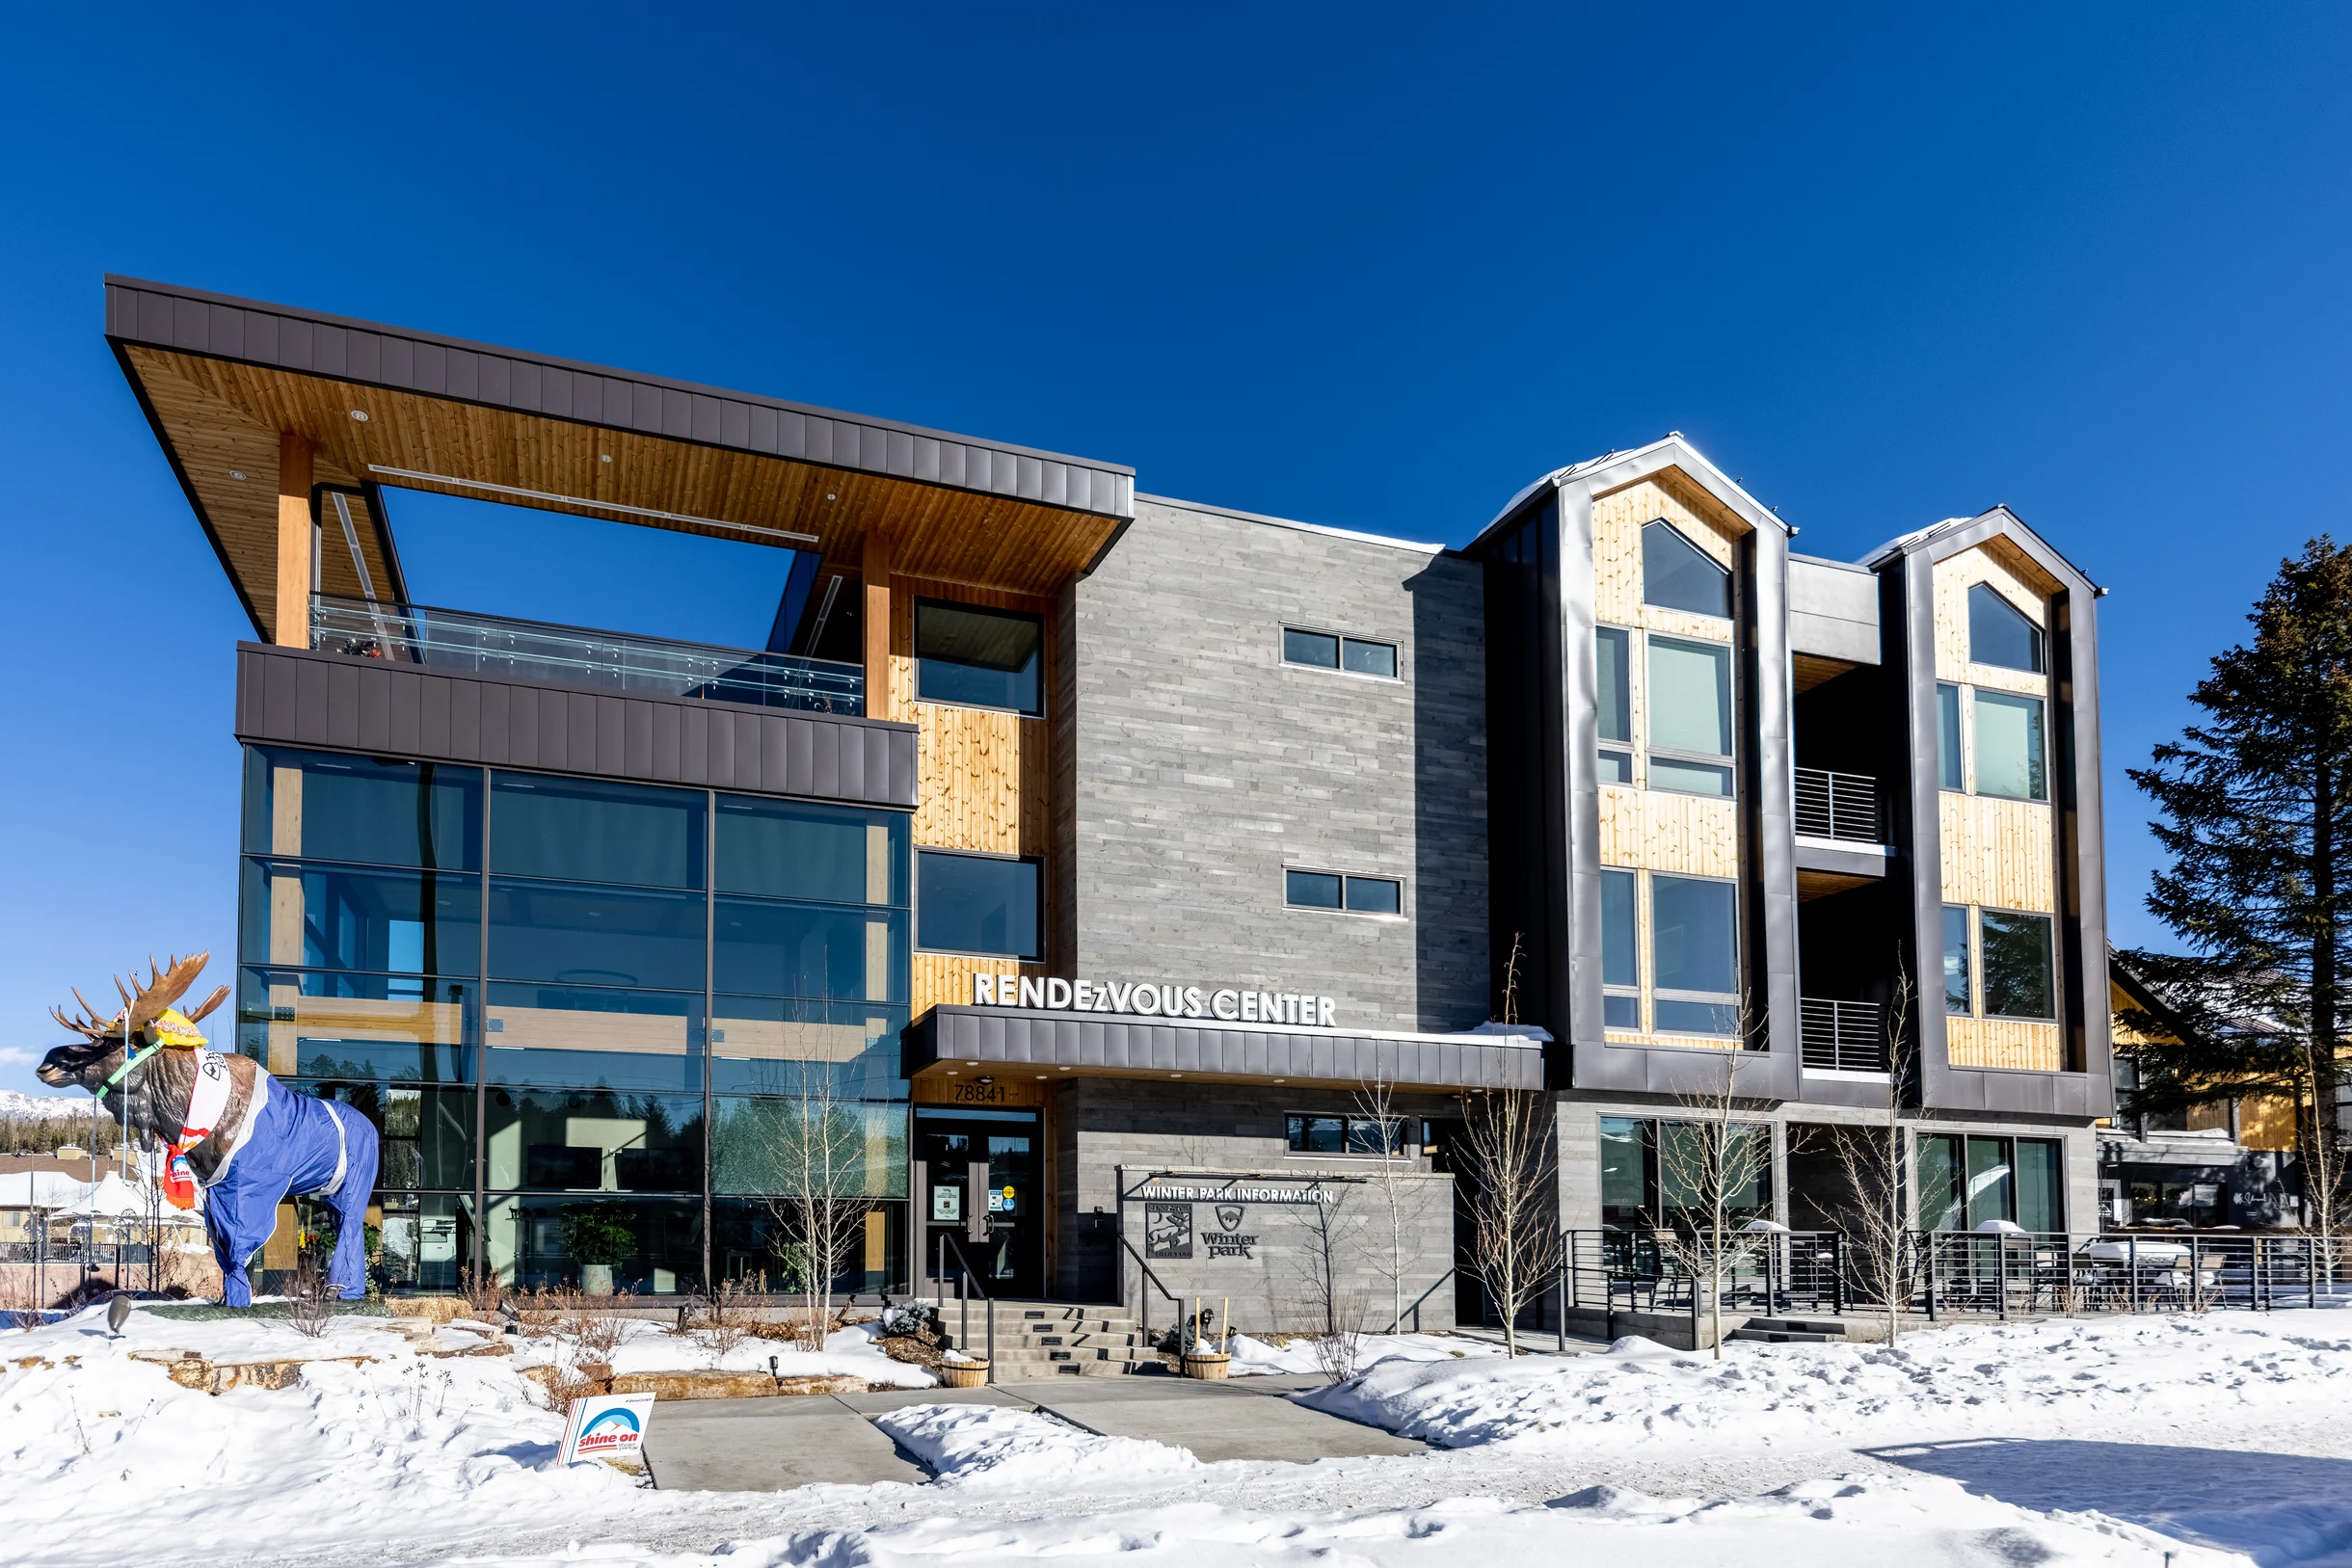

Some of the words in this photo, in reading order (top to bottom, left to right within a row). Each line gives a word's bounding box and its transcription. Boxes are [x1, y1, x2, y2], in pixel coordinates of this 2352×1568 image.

[1210, 989, 1337, 1027] CENTER
[954, 1084, 1004, 1103] 78841
[1142, 1186, 1193, 1200] WINTER
[1199, 1187, 1233, 1201] PARK
[1237, 1188, 1333, 1203] INFORMATION
[1201, 1233, 1259, 1246] Winter
[578, 1433, 618, 1447] shine
[619, 1433, 638, 1442] on
